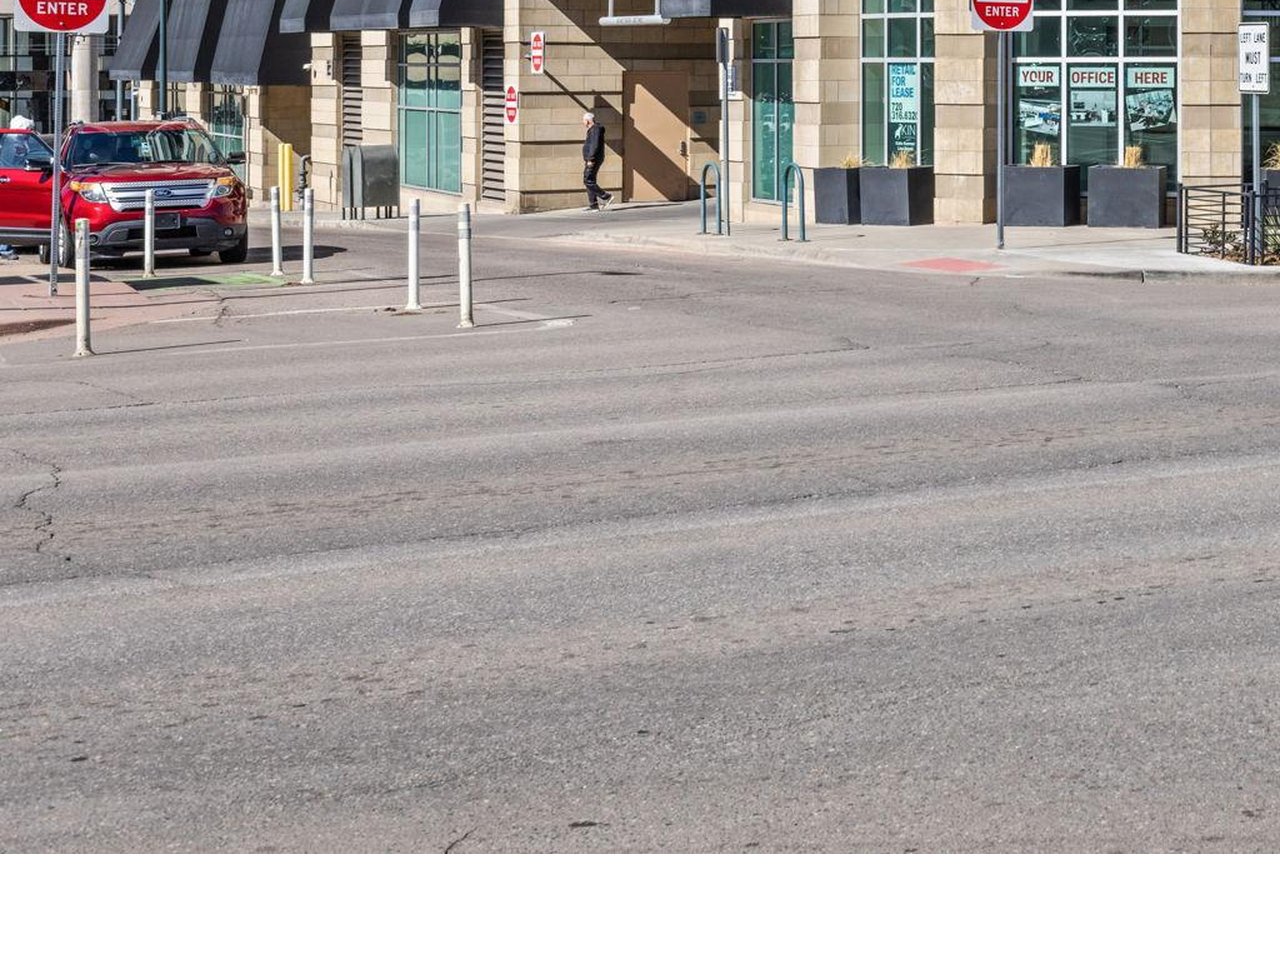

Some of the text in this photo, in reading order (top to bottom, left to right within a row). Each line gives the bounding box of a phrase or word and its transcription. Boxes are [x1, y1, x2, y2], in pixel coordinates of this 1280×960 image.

[37, 1, 88, 16] ENTER
[985, 5, 1020, 17] ENTER
[1240, 32, 1266, 44] LEFT LANE
[1245, 52, 1261, 64] MUST
[891, 64, 916, 75] RETAIL
[891, 76, 906, 86] FOR
[1022, 71, 1168, 84] YOUR OFFICE HERE
[1240, 72, 1267, 83] TURN LEFT
[891, 87, 914, 98] LEASE
[891, 102, 903, 111] 720
